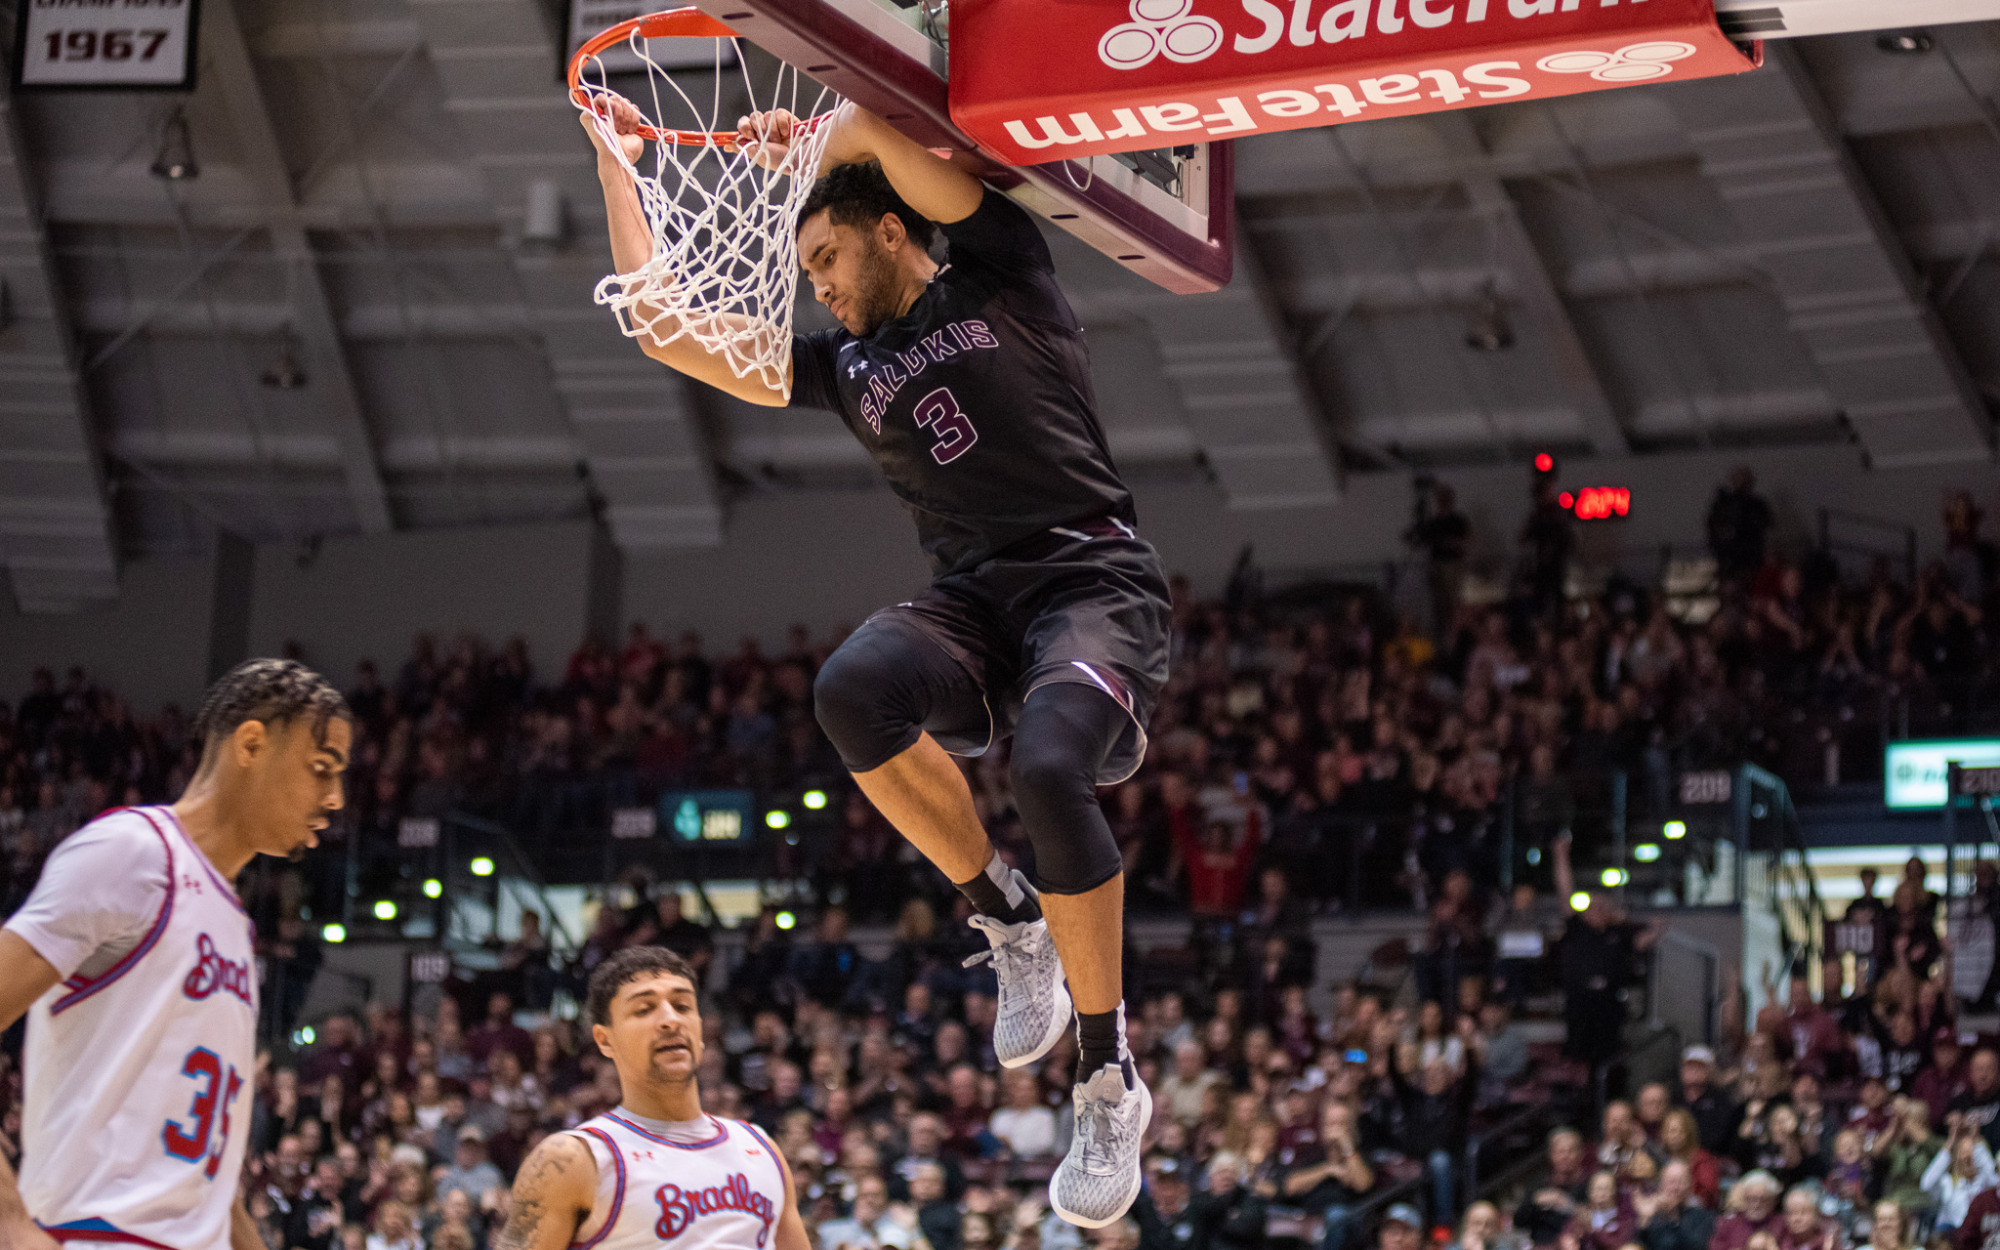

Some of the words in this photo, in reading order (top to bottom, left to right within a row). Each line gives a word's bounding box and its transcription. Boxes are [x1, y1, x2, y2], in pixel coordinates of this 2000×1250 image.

[43, 29, 169, 61] 1967
[860, 320, 999, 435] SALUKIS
[913, 386, 979, 465] 3
[161, 1045, 243, 1181] 35
[655, 1172, 775, 1249] Bradley
